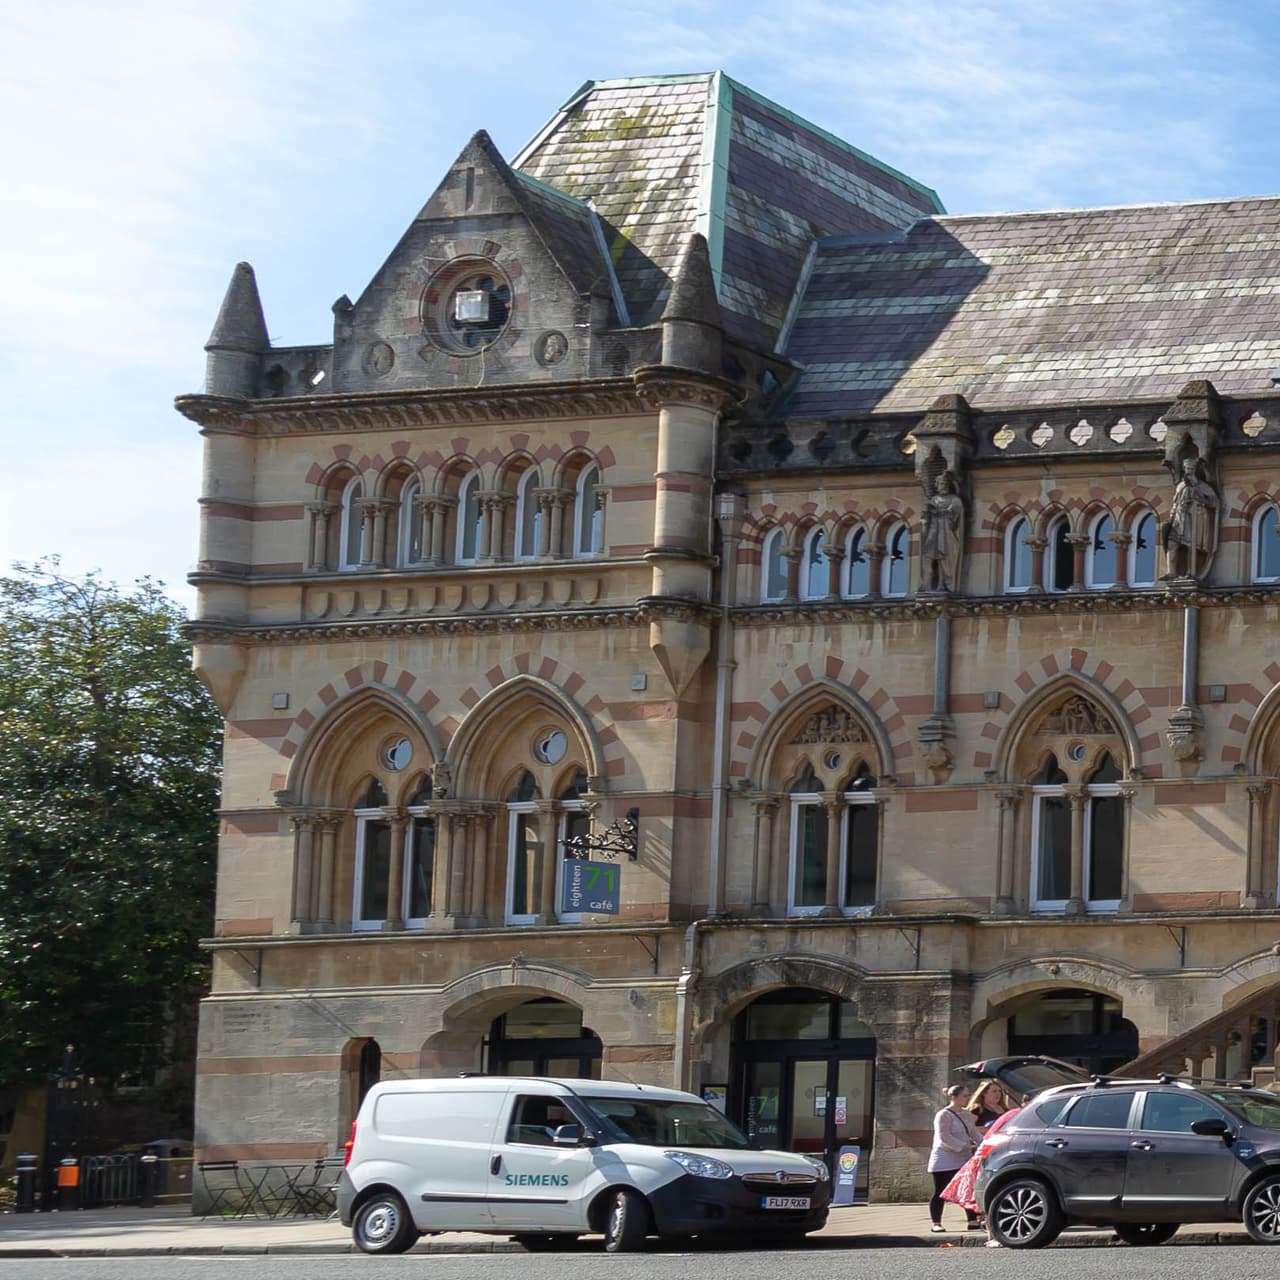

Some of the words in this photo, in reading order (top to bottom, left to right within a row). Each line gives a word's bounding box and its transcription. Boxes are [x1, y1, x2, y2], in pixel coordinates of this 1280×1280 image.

[570, 865, 582, 907] eighteen
[584, 866, 615, 893] 71
[590, 900, 613, 910] café
[757, 1096, 779, 1115] 71
[505, 1174, 569, 1186] SIEMENS
